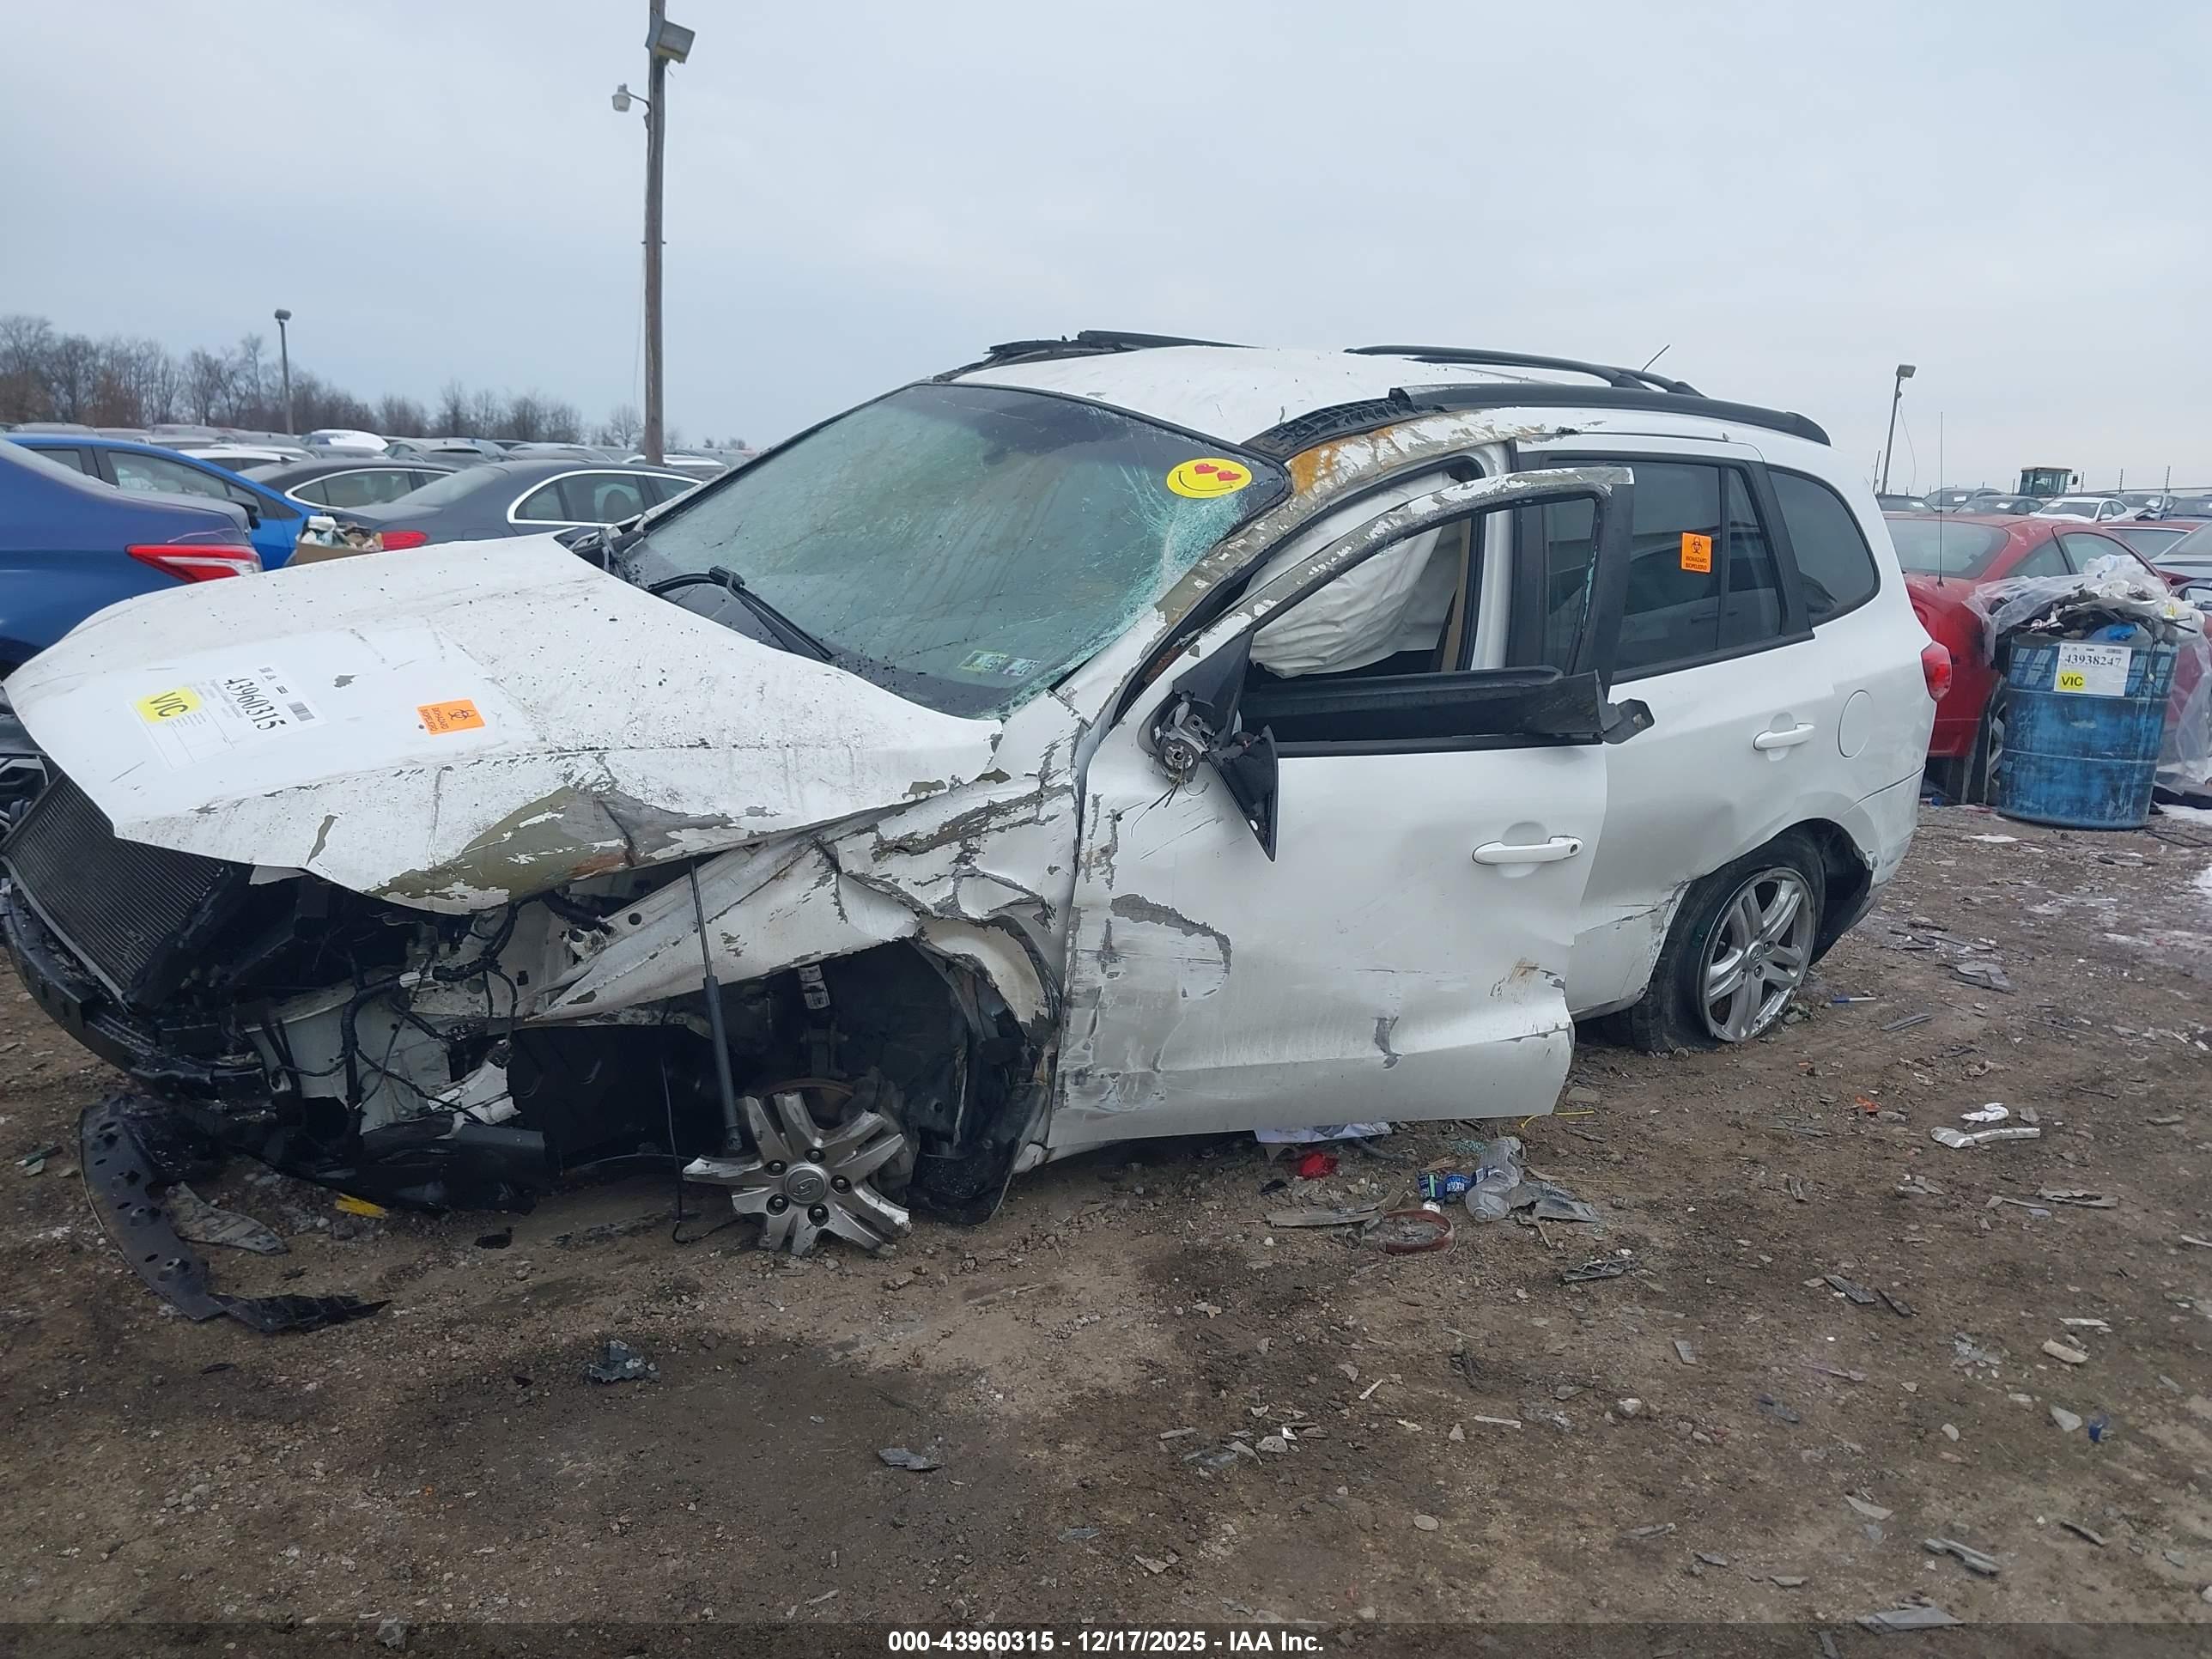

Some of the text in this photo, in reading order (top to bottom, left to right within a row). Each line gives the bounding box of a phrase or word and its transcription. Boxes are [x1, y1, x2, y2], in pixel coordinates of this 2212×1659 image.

[2065, 654, 2121, 666] 43938247
[2062, 676, 2083, 687] VIC
[149, 691, 189, 718] VIC
[222, 677, 287, 732] 43960315
